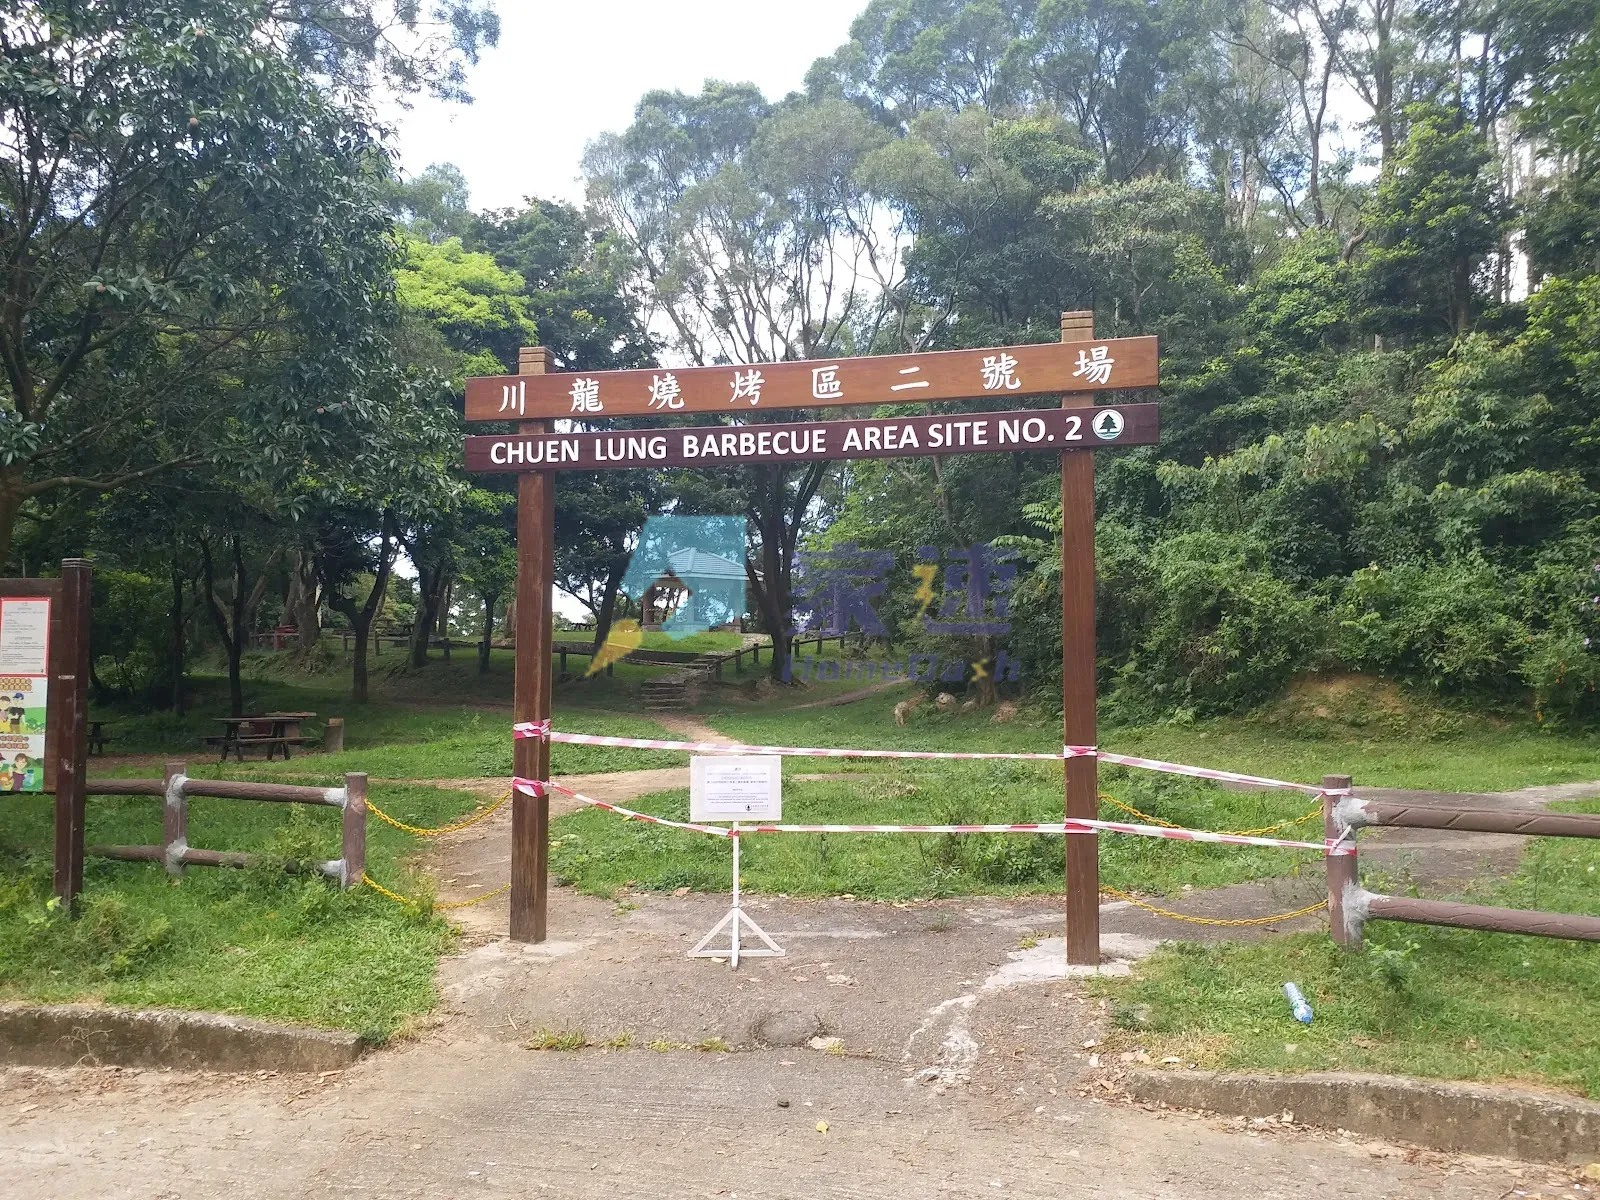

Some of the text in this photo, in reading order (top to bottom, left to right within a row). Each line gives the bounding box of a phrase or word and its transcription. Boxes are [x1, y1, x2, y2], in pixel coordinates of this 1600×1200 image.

[498, 345, 1116, 416] 川龍燒烤區二號場
[490, 415, 1084, 465] CHUEN LUNG BARBECUE AREA SITE NO. 2
